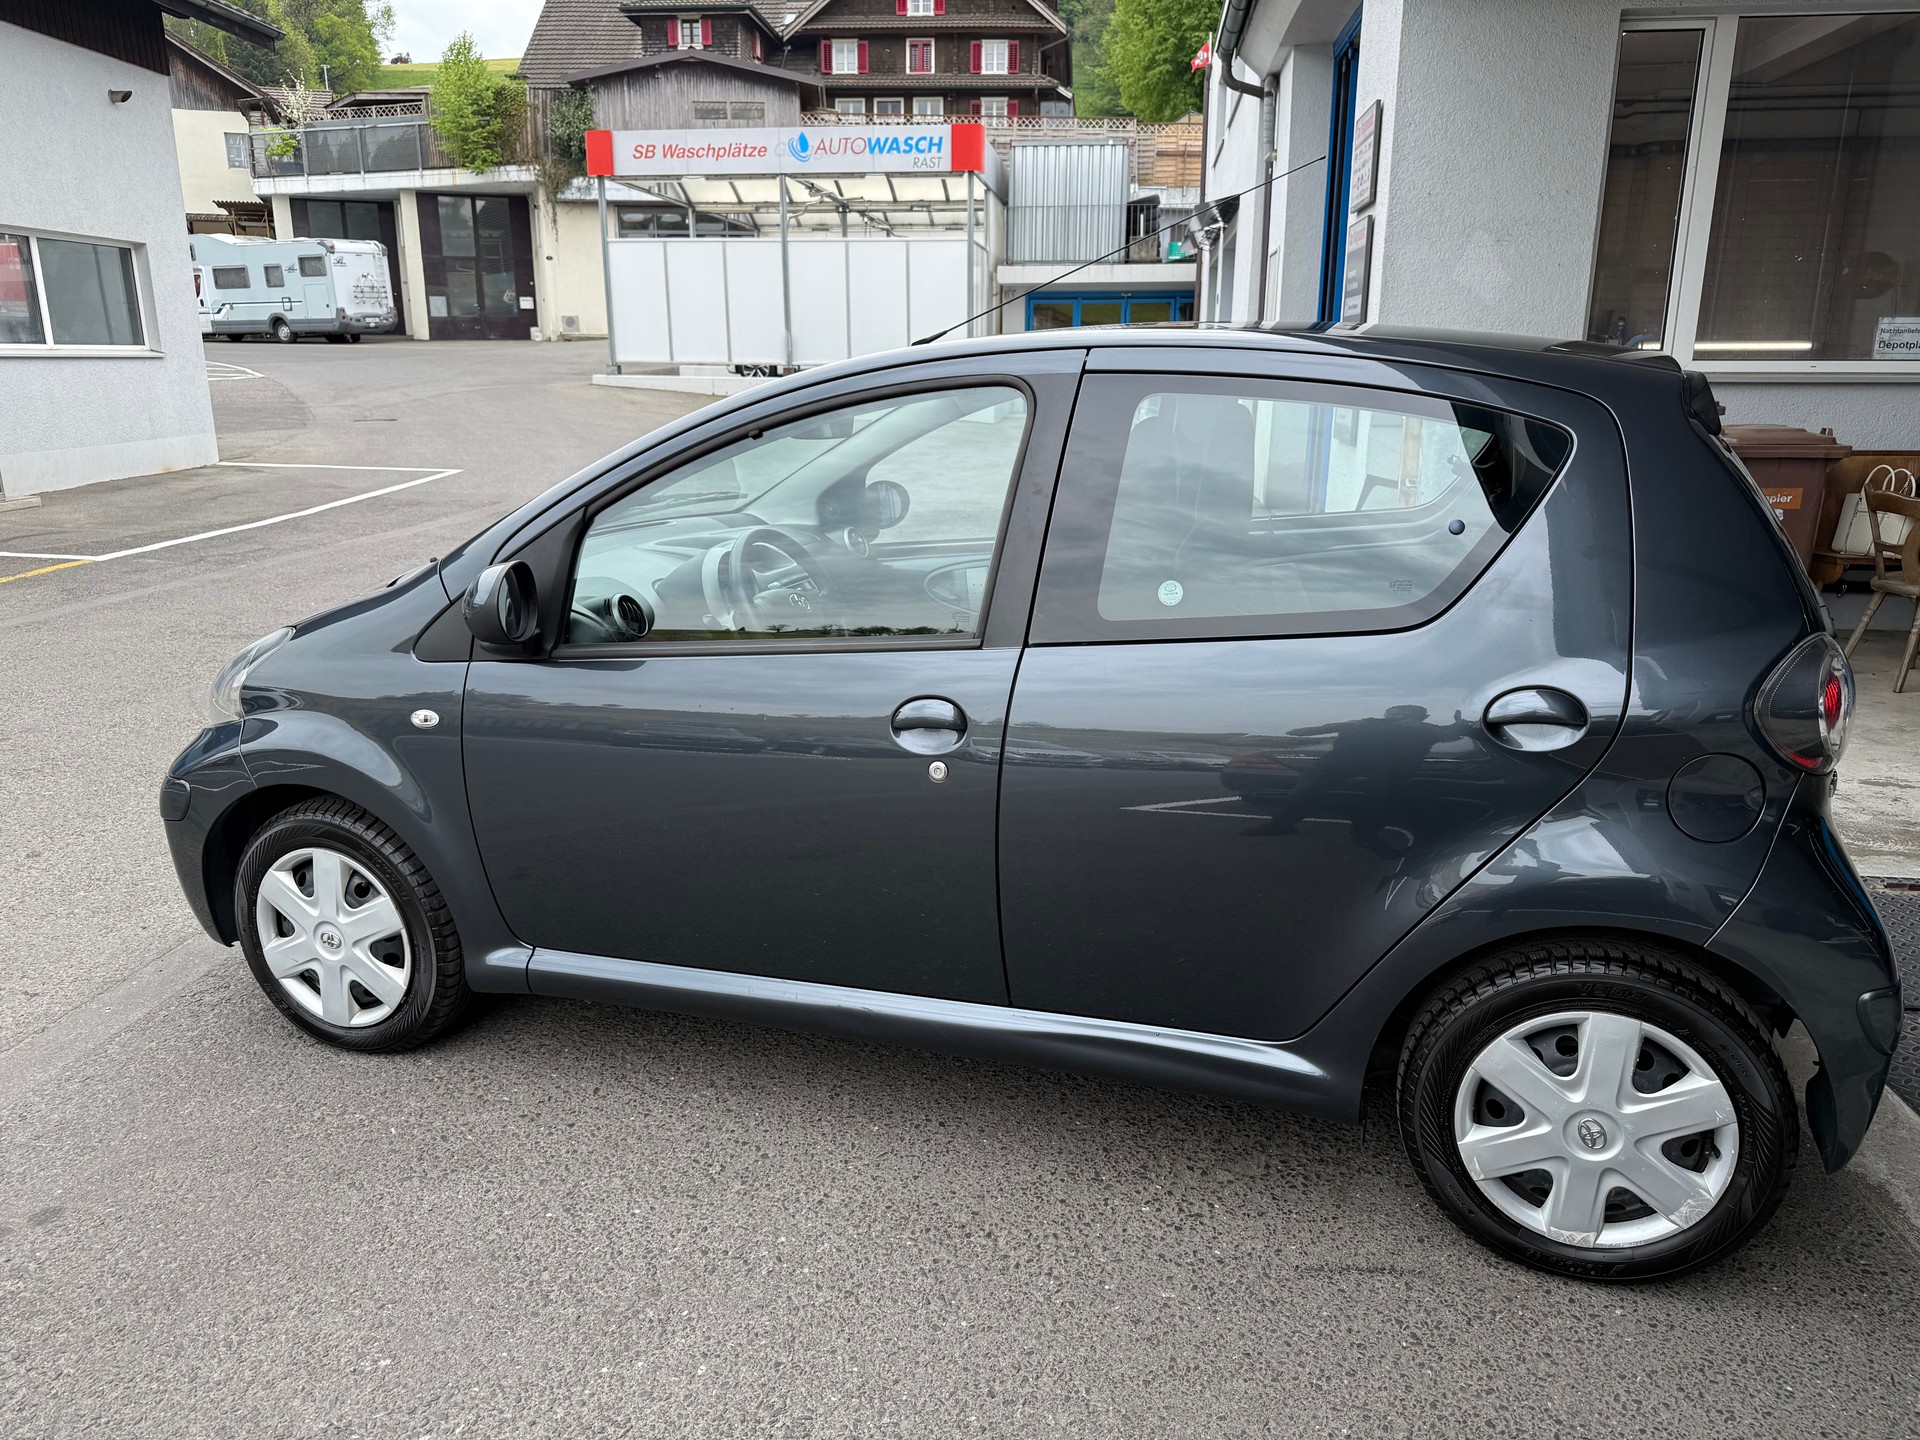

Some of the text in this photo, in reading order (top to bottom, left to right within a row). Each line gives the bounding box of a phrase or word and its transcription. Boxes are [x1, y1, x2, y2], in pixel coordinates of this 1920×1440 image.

[632, 144, 657, 160] SB
[662, 142, 768, 161] Waschplätze
[814, 136, 943, 155] AUTOWASCH
[912, 156, 943, 169] RAST
